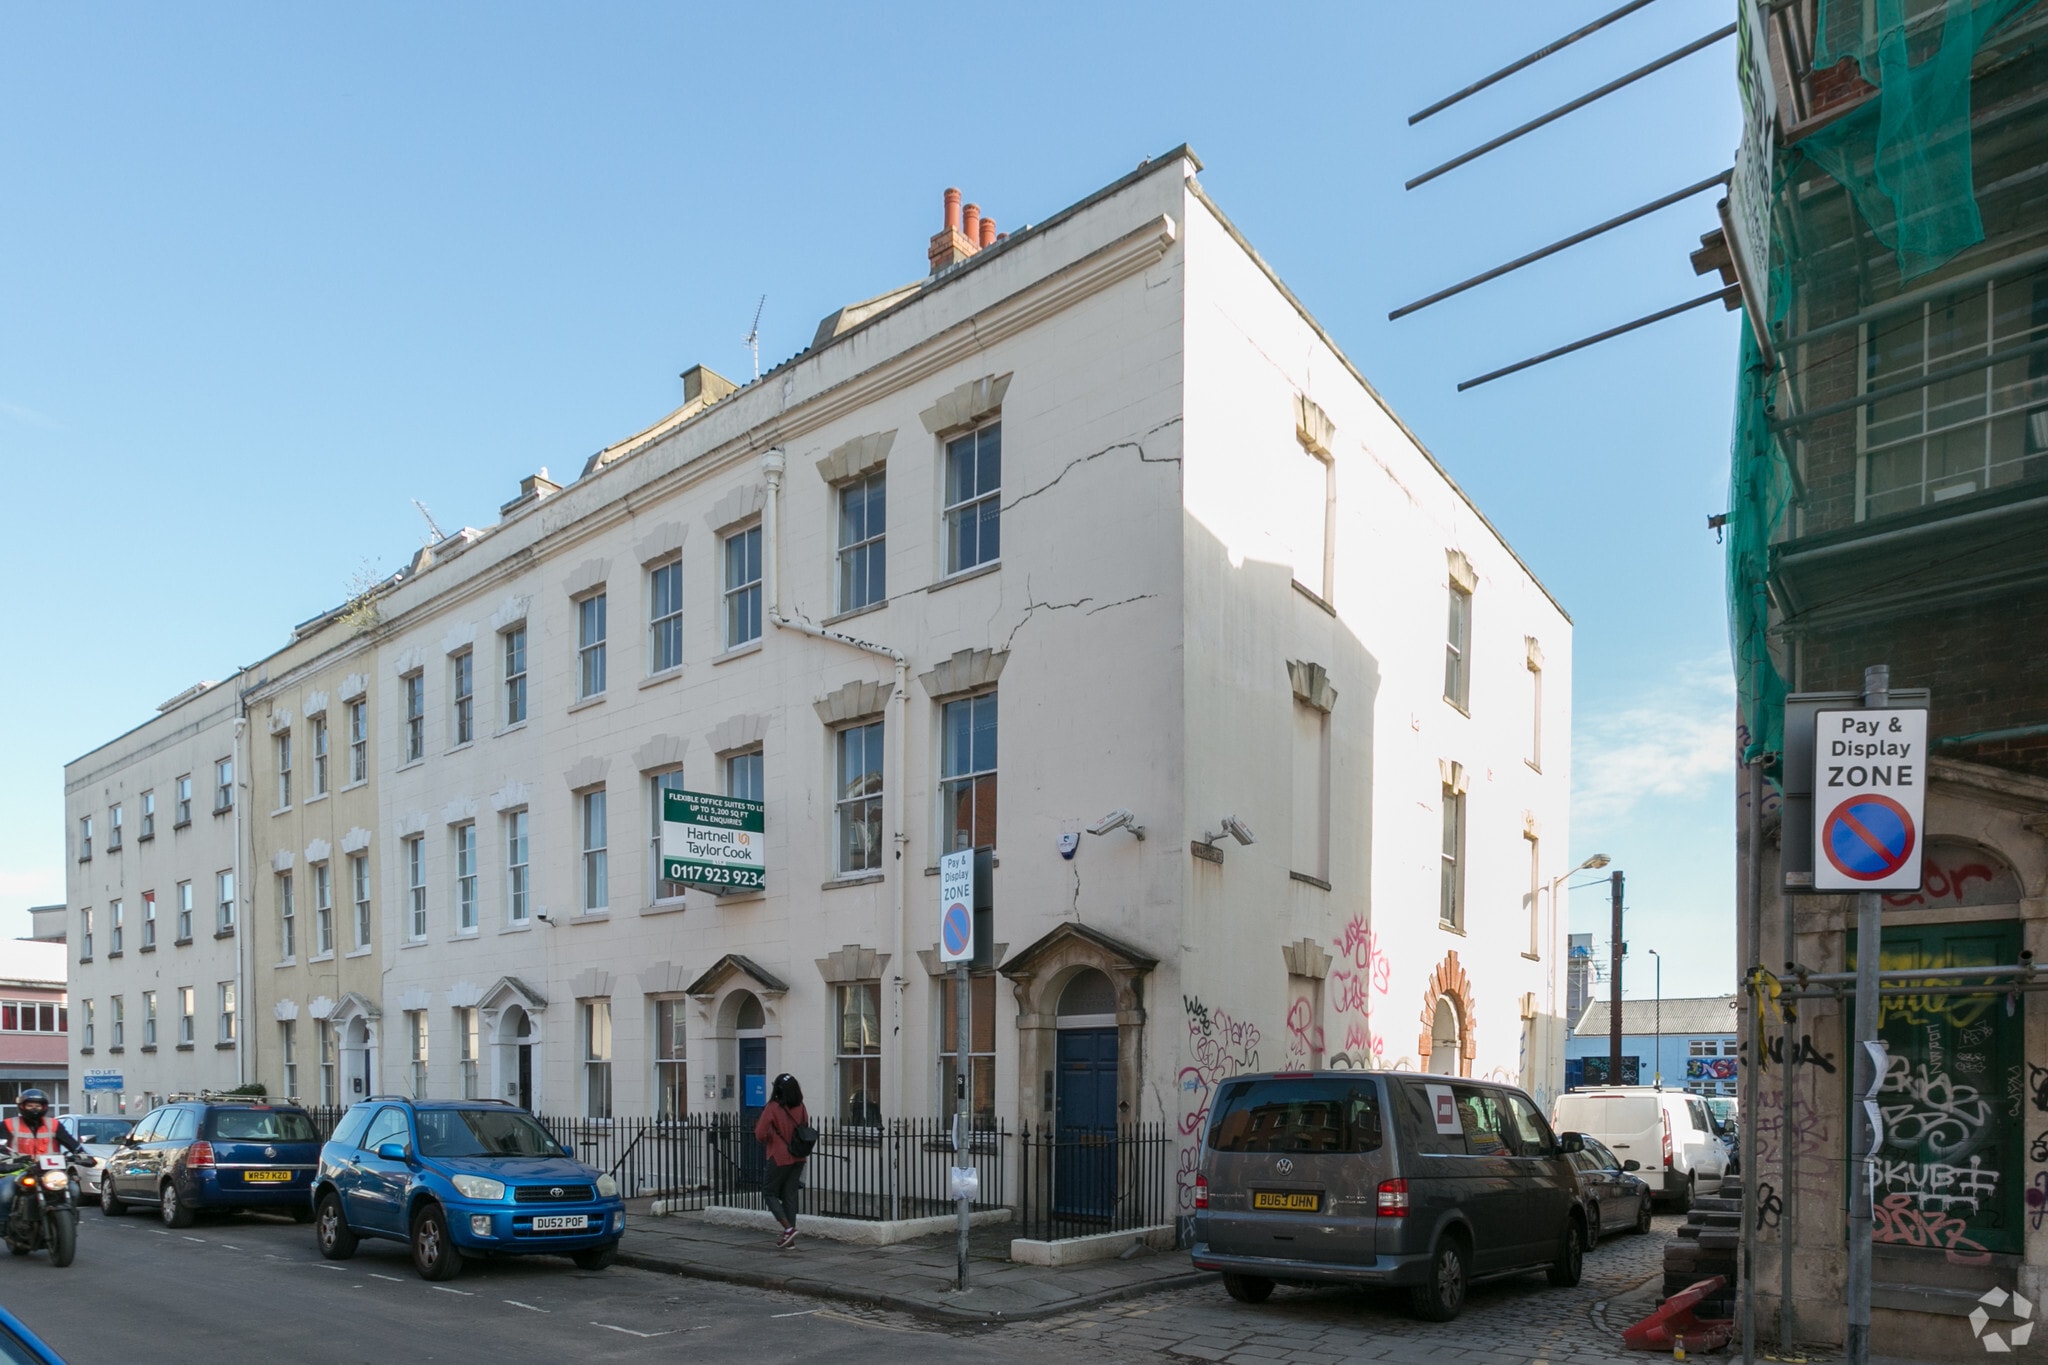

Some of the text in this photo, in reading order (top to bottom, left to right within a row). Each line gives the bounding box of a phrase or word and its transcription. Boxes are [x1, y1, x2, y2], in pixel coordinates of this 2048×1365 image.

[1842, 716, 1902, 736] Pay &
[1832, 739, 1911, 759] Display
[1828, 765, 1913, 787] ZONE
[669, 793, 699, 803] FLEXIBLE
[700, 797, 723, 807] OFFICE
[724, 800, 746, 810] SUITES
[747, 803, 756, 812] TO
[690, 804, 700, 812] UP
[700, 805, 709, 813] TO
[710, 807, 730, 816] 5,200
[730, 810, 740, 818] SQ
[696, 814, 743, 826] ALL ENQUIRIES
[687, 826, 734, 844] Hartnell
[686, 841, 752, 860] Taylor Cook
[947, 855, 966, 869] Pay &
[671, 863, 703, 880] 0117
[704, 867, 730, 883] 923
[945, 869, 969, 883] Display
[944, 883, 970, 901] ZONE
[46, 1157, 59, 1166] L
[1259, 1194, 1288, 1207] BU63
[1291, 1195, 1314, 1208] UHN
[537, 1216, 583, 1228] DU52 POF
